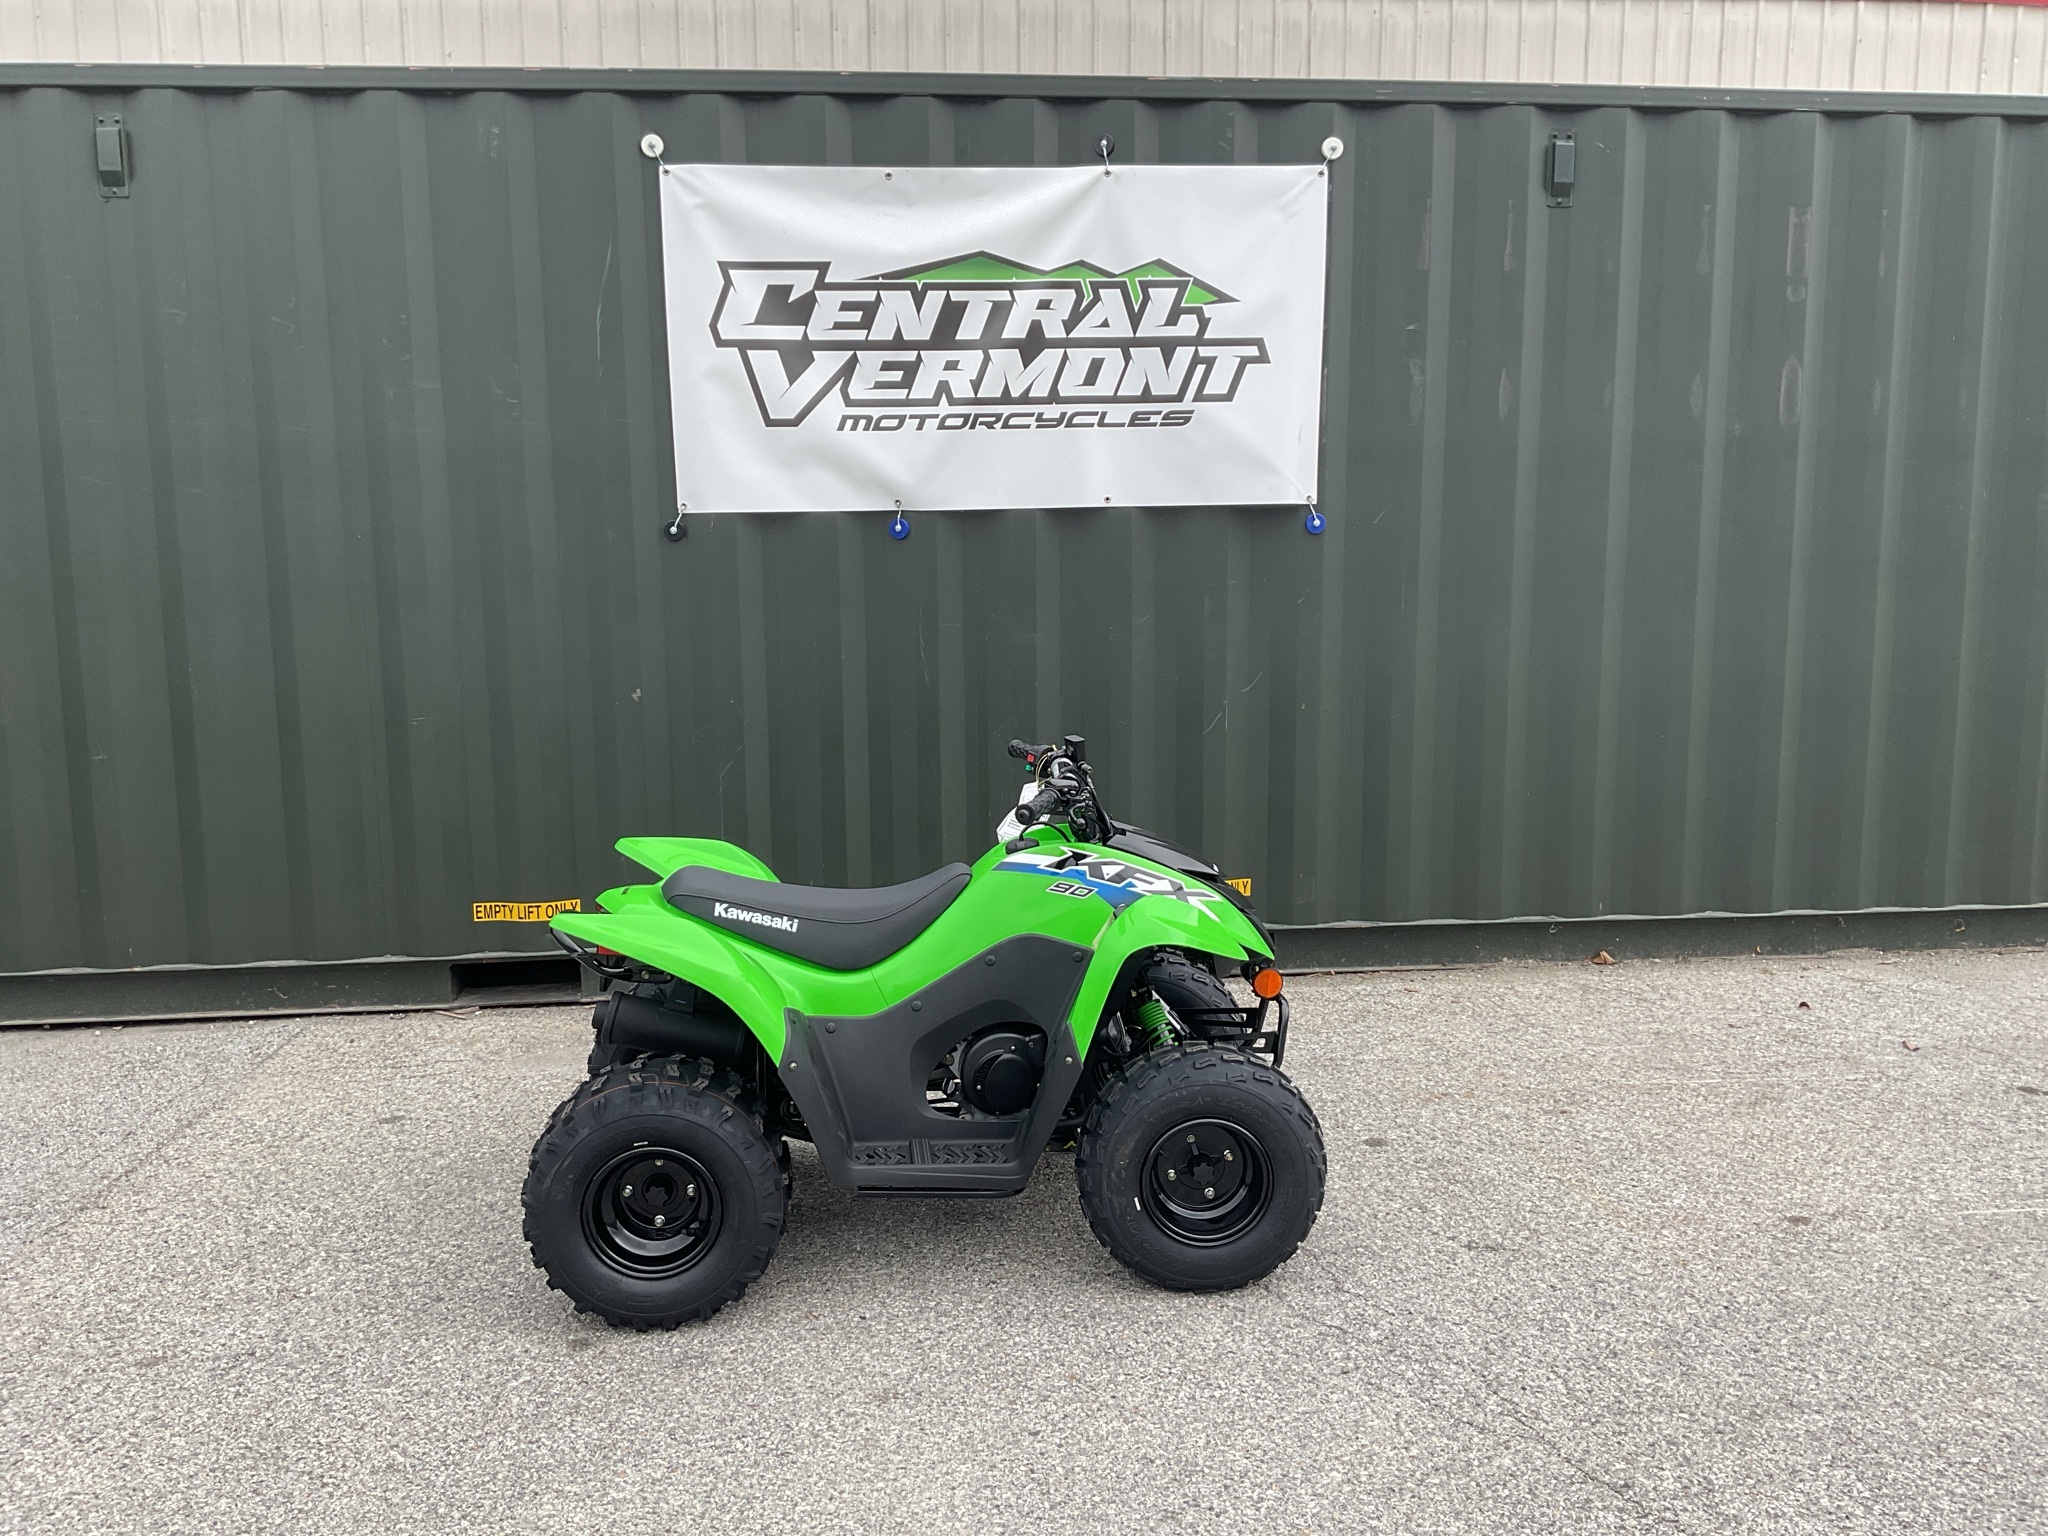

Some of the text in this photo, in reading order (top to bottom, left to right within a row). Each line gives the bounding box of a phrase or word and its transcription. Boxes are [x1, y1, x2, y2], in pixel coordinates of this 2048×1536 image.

[713, 262, 1227, 344] CENTRAL
[742, 345, 1264, 424] VERMONT
[837, 409, 1195, 432] MOTORCYCLES
[1038, 847, 1222, 921] KFX
[1047, 881, 1098, 899] 90
[475, 904, 514, 920] EMPTY
[518, 905, 541, 920] LIFT
[714, 902, 799, 933] Kawasaki
